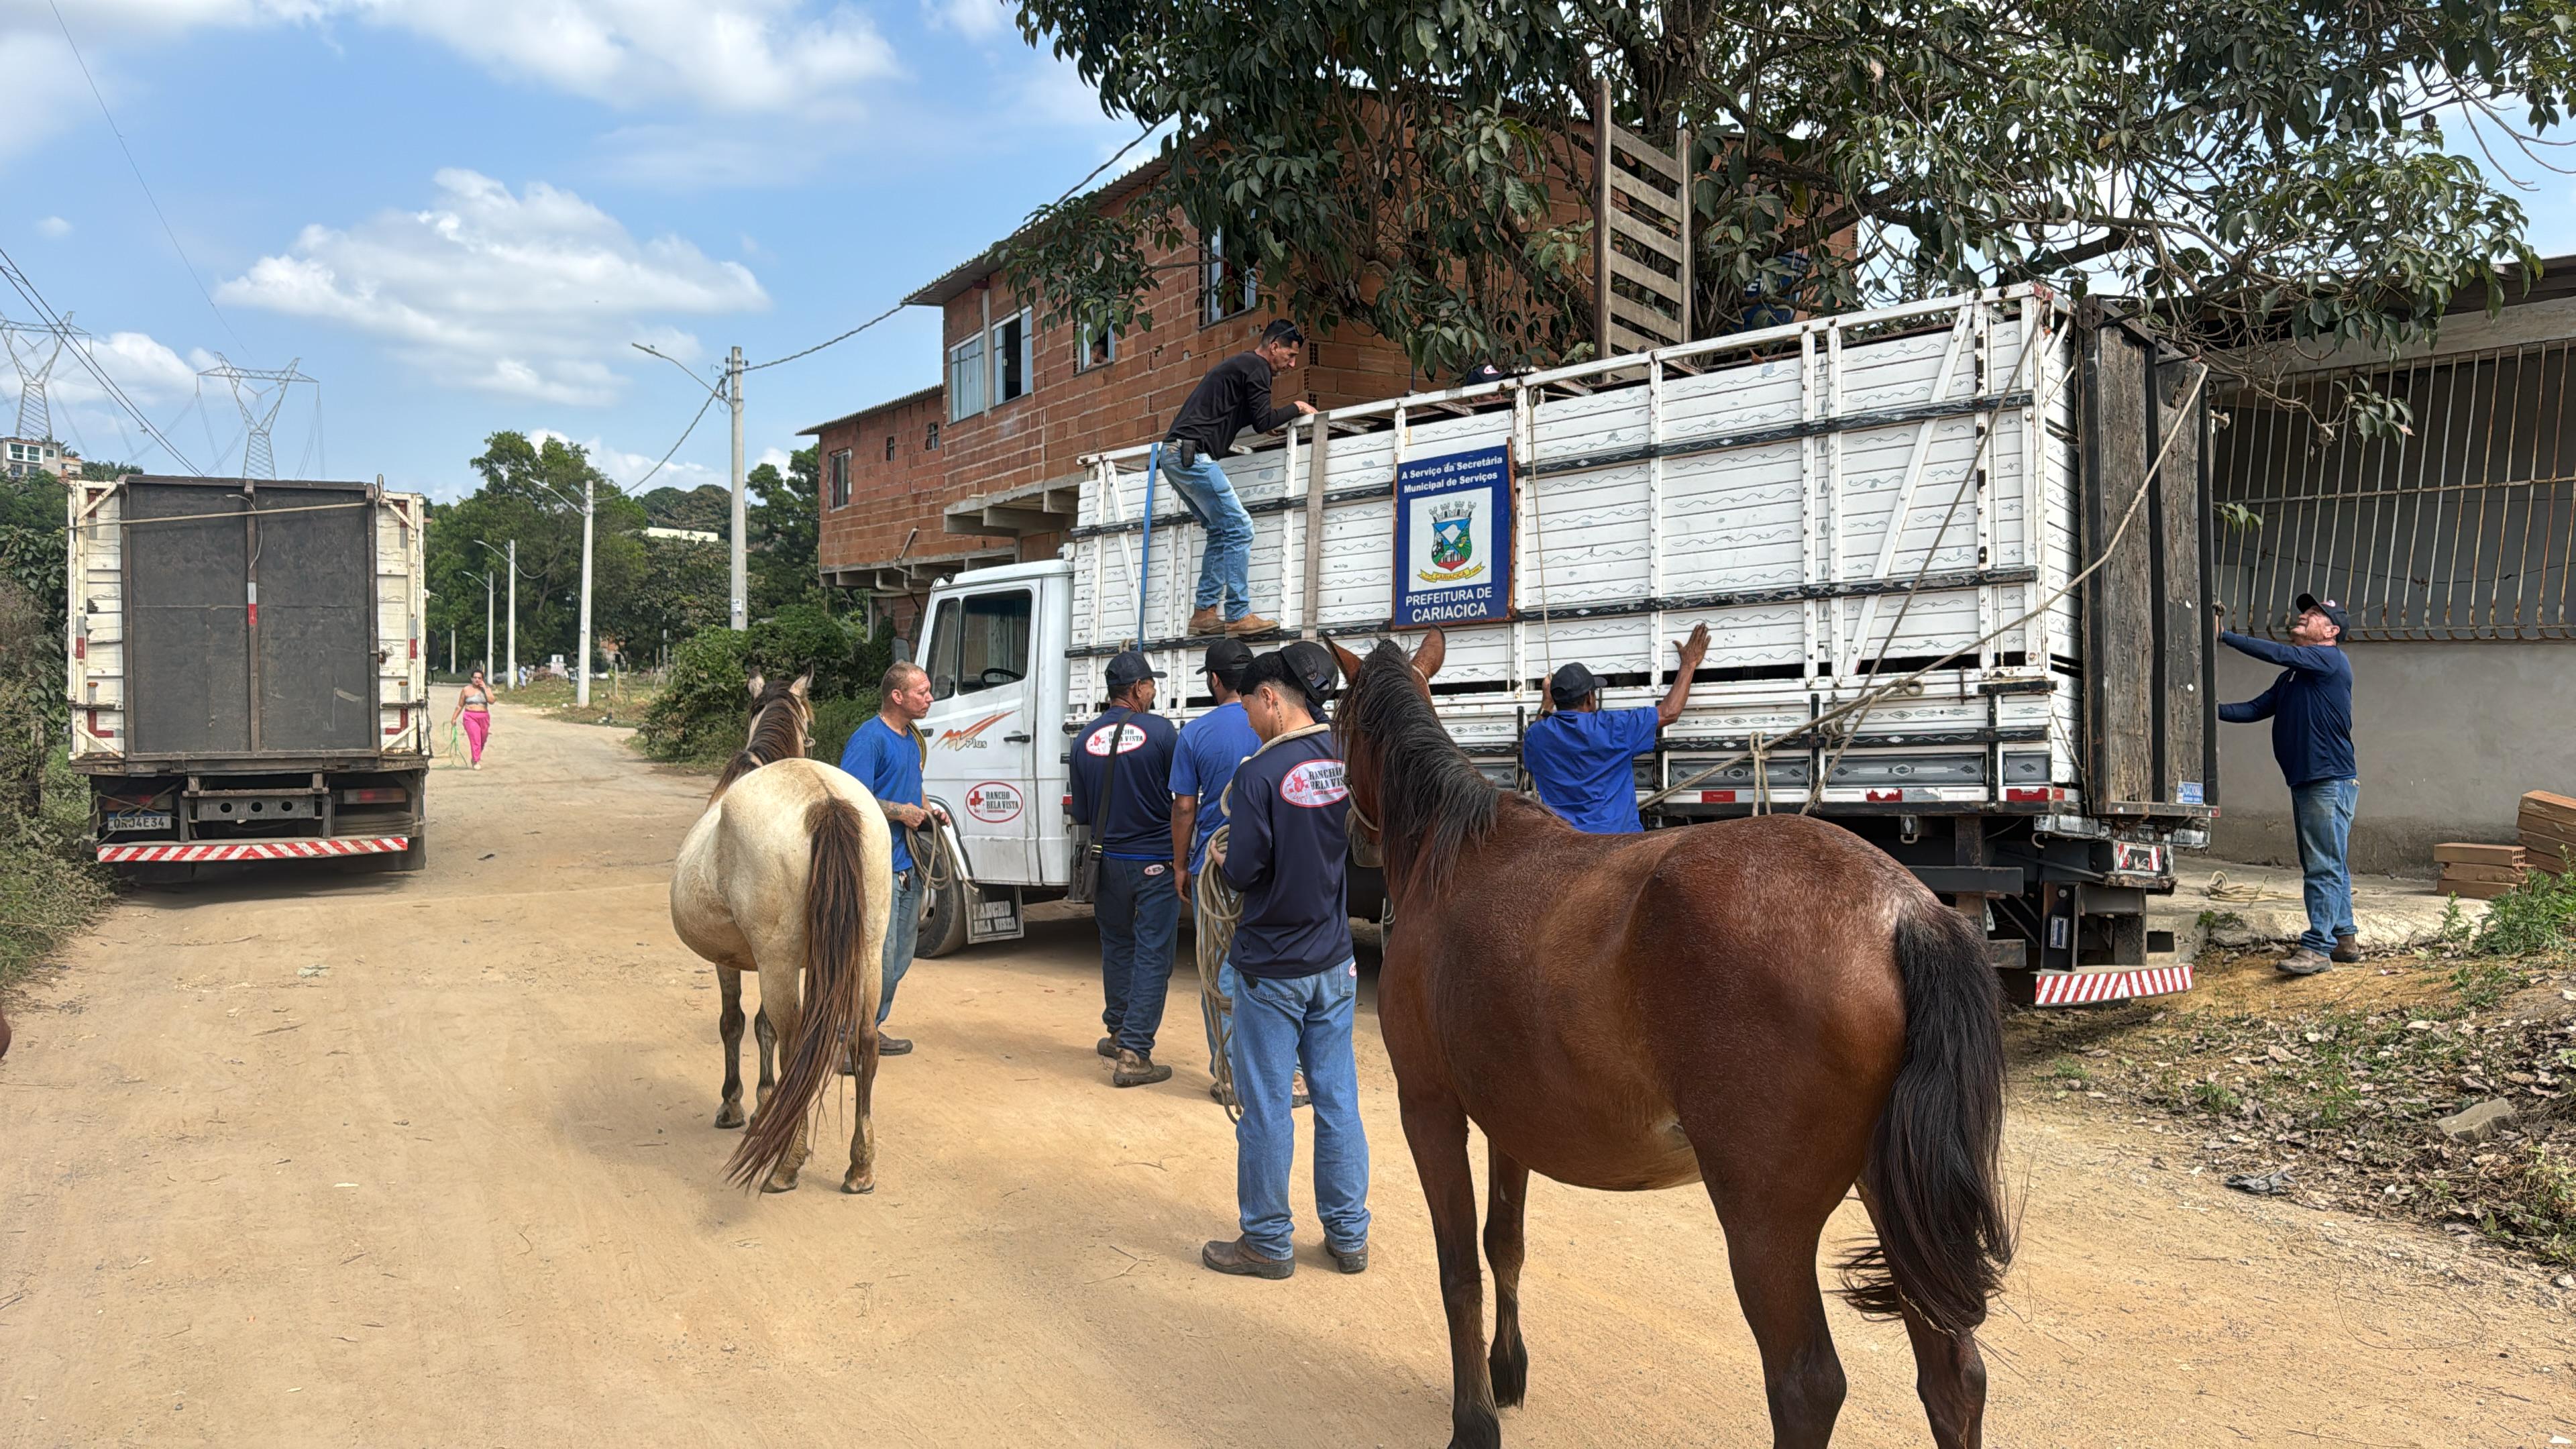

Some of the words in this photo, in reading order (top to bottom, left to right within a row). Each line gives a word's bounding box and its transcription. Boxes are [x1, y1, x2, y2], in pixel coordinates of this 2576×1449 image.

[1401, 471, 1408, 480] A
[1409, 467, 1442, 479] Serviço
[1444, 463, 1454, 473] da
[1456, 455, 1503, 470] Secretária
[1403, 479, 1444, 493] Municipal
[1446, 478, 1457, 487] de
[1459, 472, 1497, 484] Serviços
[1405, 588, 1474, 606] PREFEITURA
[1477, 586, 1492, 599] DE
[1412, 602, 1487, 623] CARIACICA
[966, 738, 987, 749] Plus
[1309, 767, 1342, 780] RANCHO
[1310, 779, 1330, 790] BELA
[985, 791, 1010, 800] RANCHO
[986, 800, 1002, 809] BELA
[1002, 800, 1019, 809] VISTA
